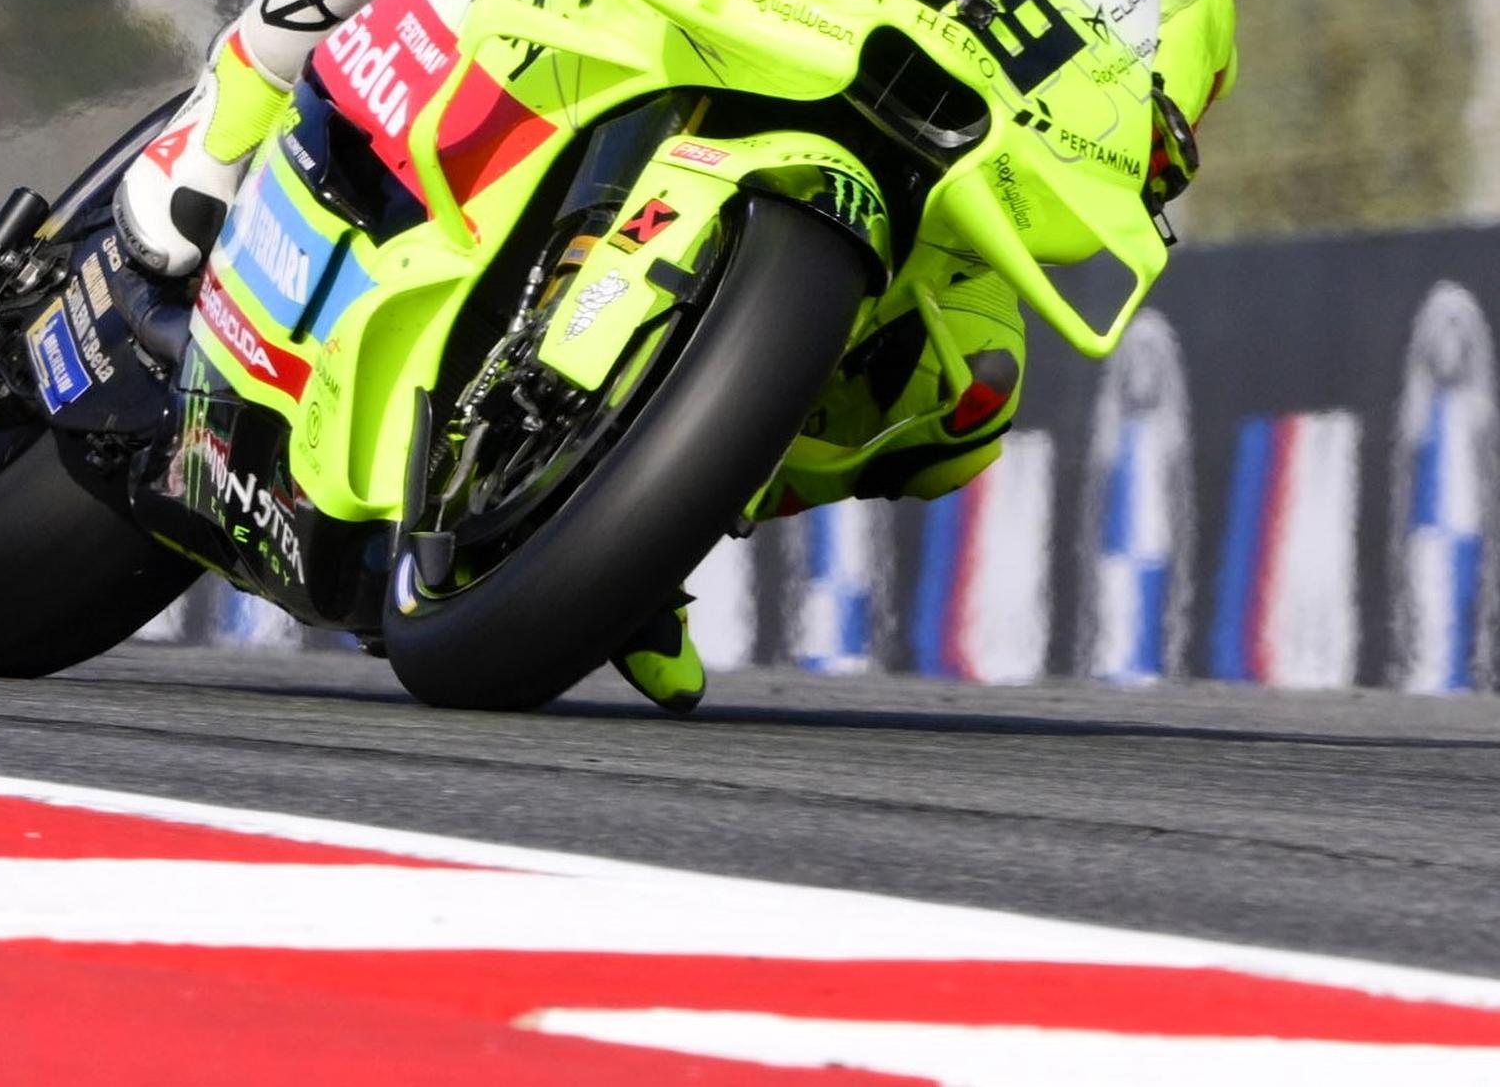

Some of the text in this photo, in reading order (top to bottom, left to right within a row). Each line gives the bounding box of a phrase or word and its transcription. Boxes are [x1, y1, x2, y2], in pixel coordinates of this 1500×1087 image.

[916, 9, 995, 80] HERO
[1060, 129, 1142, 180] PERTAMINA
[43, 333, 74, 394] MICHELIN
